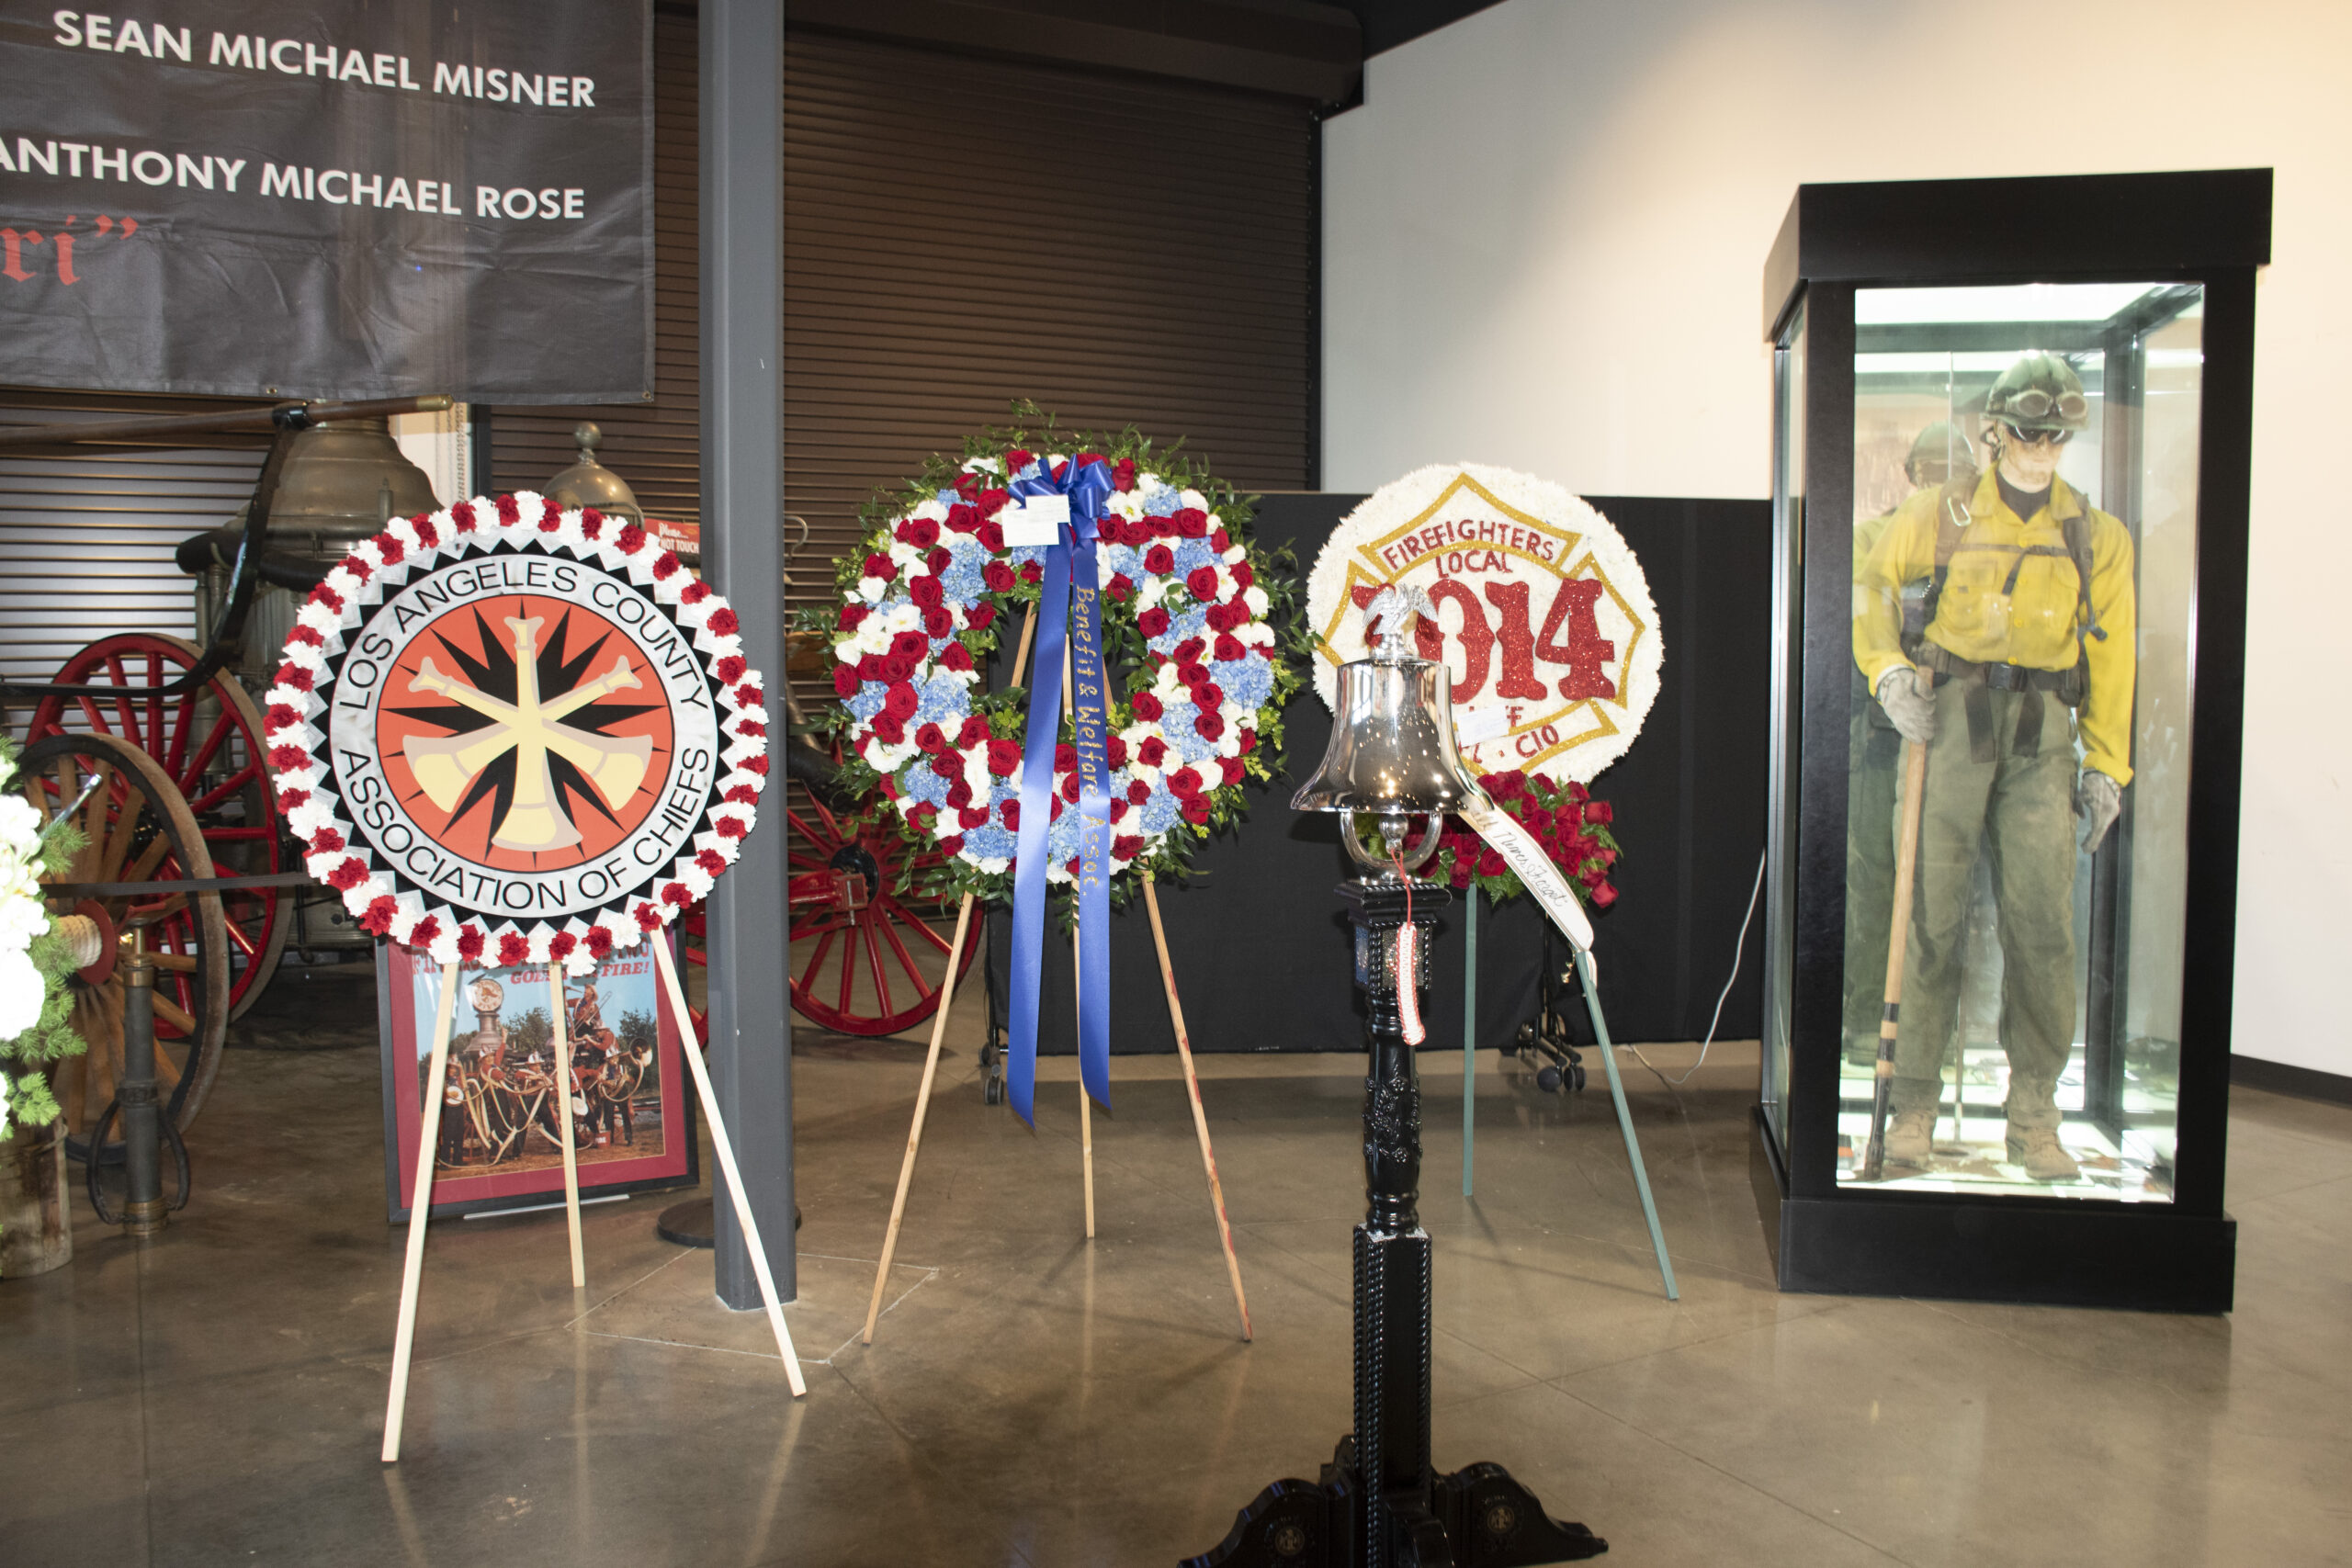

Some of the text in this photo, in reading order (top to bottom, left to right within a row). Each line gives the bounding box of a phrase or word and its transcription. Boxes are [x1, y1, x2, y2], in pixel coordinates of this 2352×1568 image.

[53, 10, 595, 107] SEAN MICHAEL MISNER
[260, 163, 461, 216] MICHAEL
[477, 186, 584, 220] ROSE
[676, 540, 700, 554] TOUCH
[1383, 519, 1554, 570] FIREFIGHTERS
[1435, 549, 1513, 579] LOCAL
[340, 561, 708, 710] LOS ANGELES COUNTY
[1074, 585, 1106, 897] Benefit & Welfare Assoc.
[1515, 724, 1560, 758] CIO
[340, 748, 709, 909] ASSOCIATION OF CHIEFS
[602, 961, 650, 977] FIRE!
